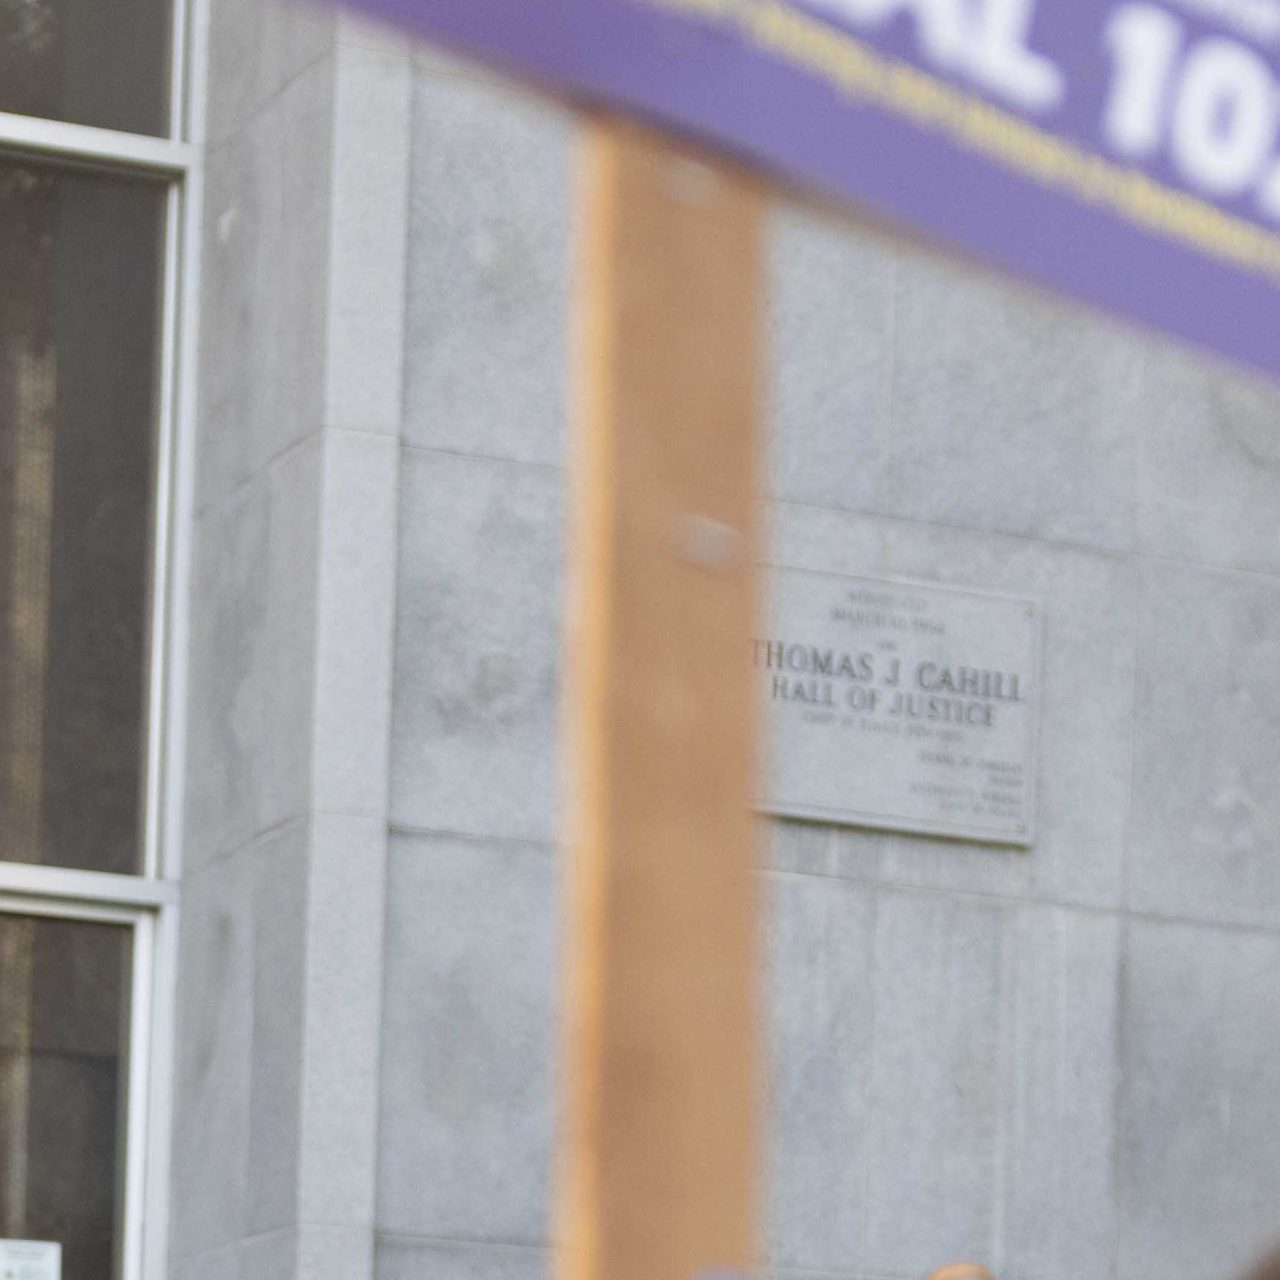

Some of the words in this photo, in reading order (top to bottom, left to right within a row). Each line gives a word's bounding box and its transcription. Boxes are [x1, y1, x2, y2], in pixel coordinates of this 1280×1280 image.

[752, 638, 874, 683] THOMAS
[917, 660, 1021, 702] CAHILL
[772, 675, 834, 706] HALL
[849, 685, 878, 711] OF
[889, 691, 994, 728] JUSTICE
